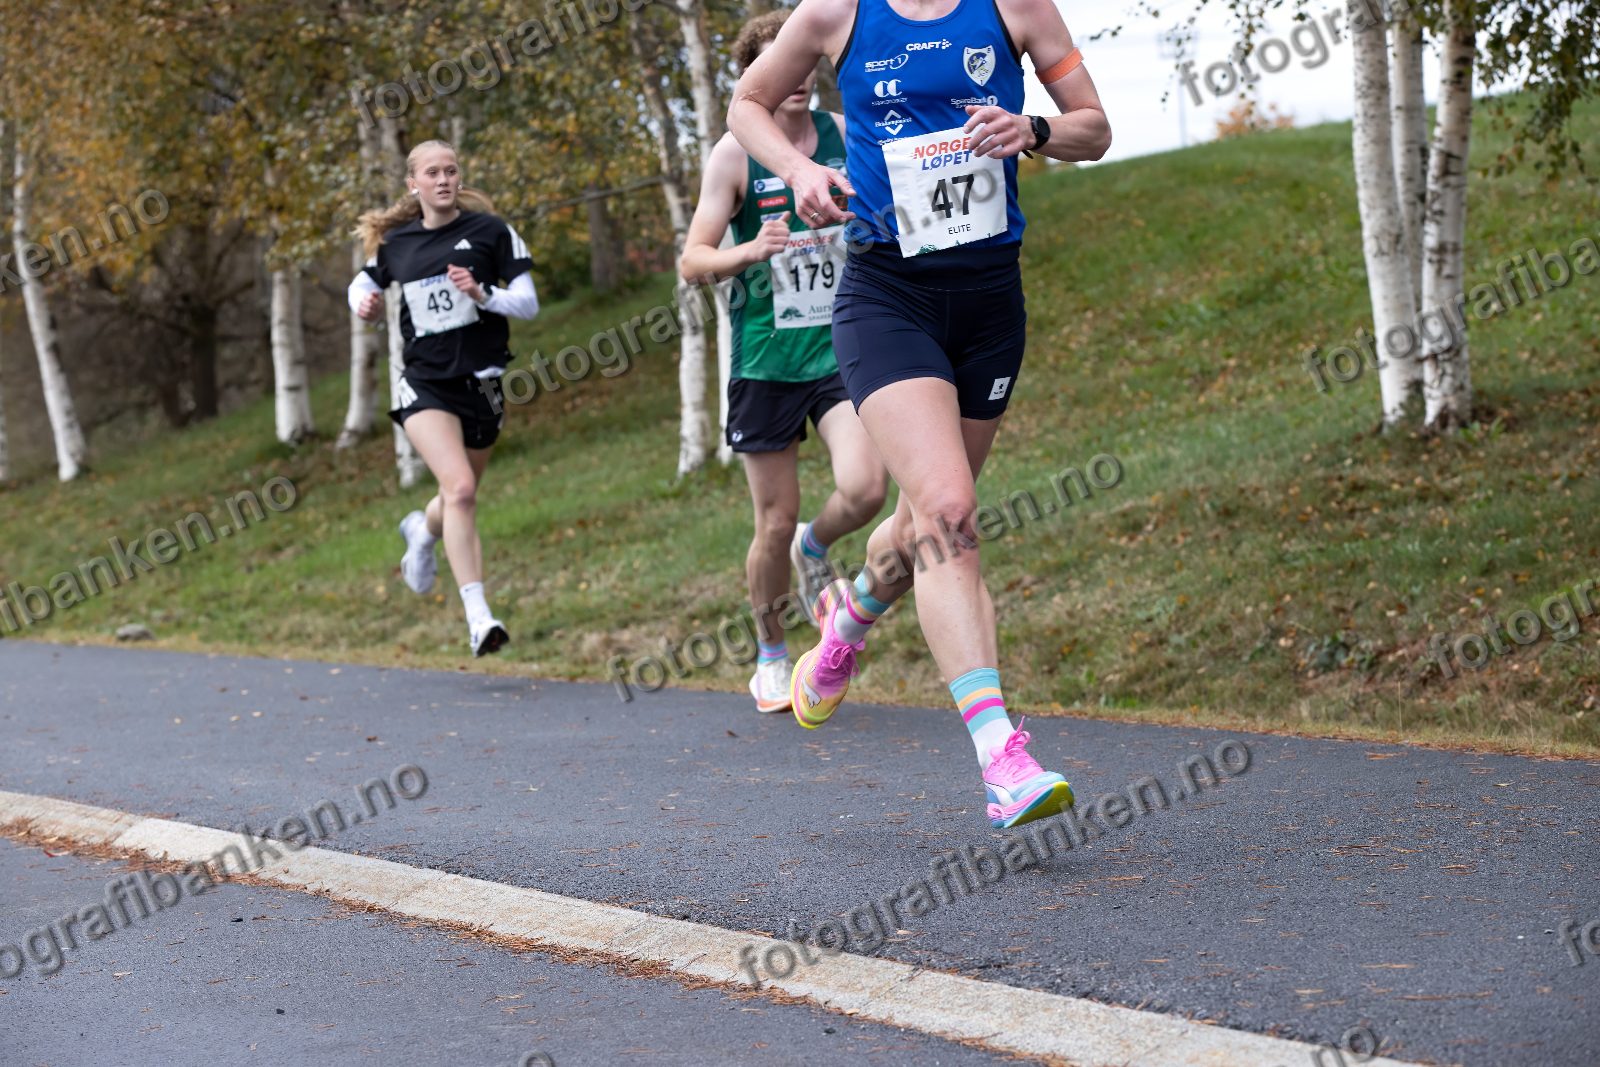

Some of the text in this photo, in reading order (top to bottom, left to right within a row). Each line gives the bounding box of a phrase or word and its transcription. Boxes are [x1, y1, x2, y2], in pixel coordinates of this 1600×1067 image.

[906, 41, 942, 51] CRAFT
[922, 150, 973, 171] LØPET
[931, 174, 974, 218] 47
[948, 224, 972, 235] ELITE
[787, 235, 834, 248] NORGES
[790, 260, 834, 293] 179
[427, 289, 453, 313] 43
